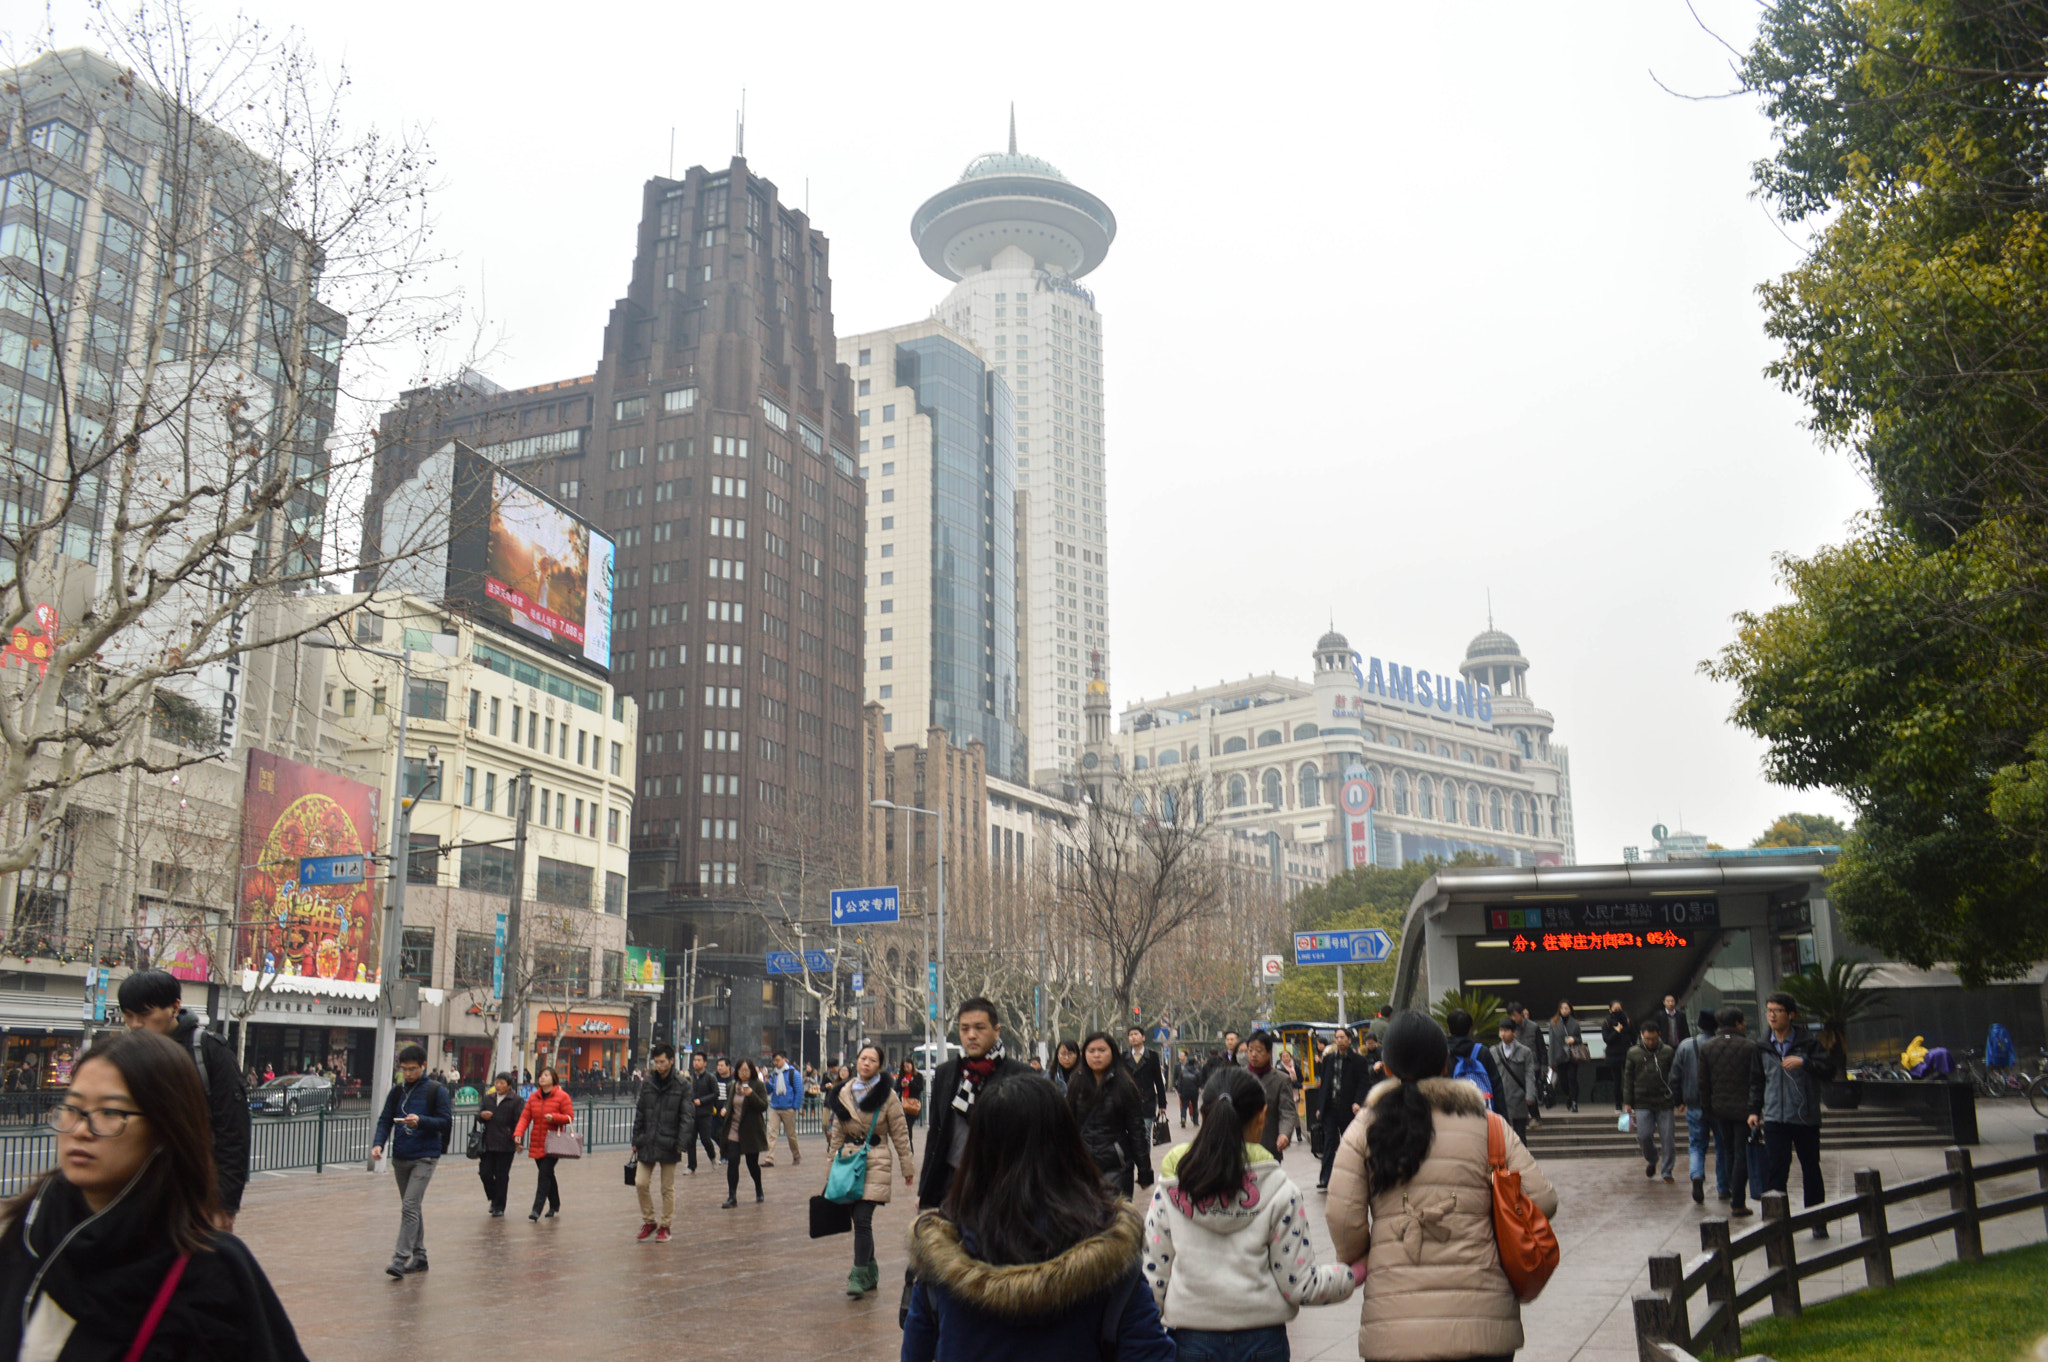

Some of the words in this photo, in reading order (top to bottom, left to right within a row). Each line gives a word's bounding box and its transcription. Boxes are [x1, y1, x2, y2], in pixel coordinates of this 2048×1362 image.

[216, 557, 245, 748] TEATRE
[1352, 650, 1493, 723] SAMSUNG
[845, 897, 896, 913] 公交专用
[1582, 902, 1654, 920] 人民广场站
[1659, 902, 1687, 924] 10
[327, 1004, 352, 1015] GRAND
